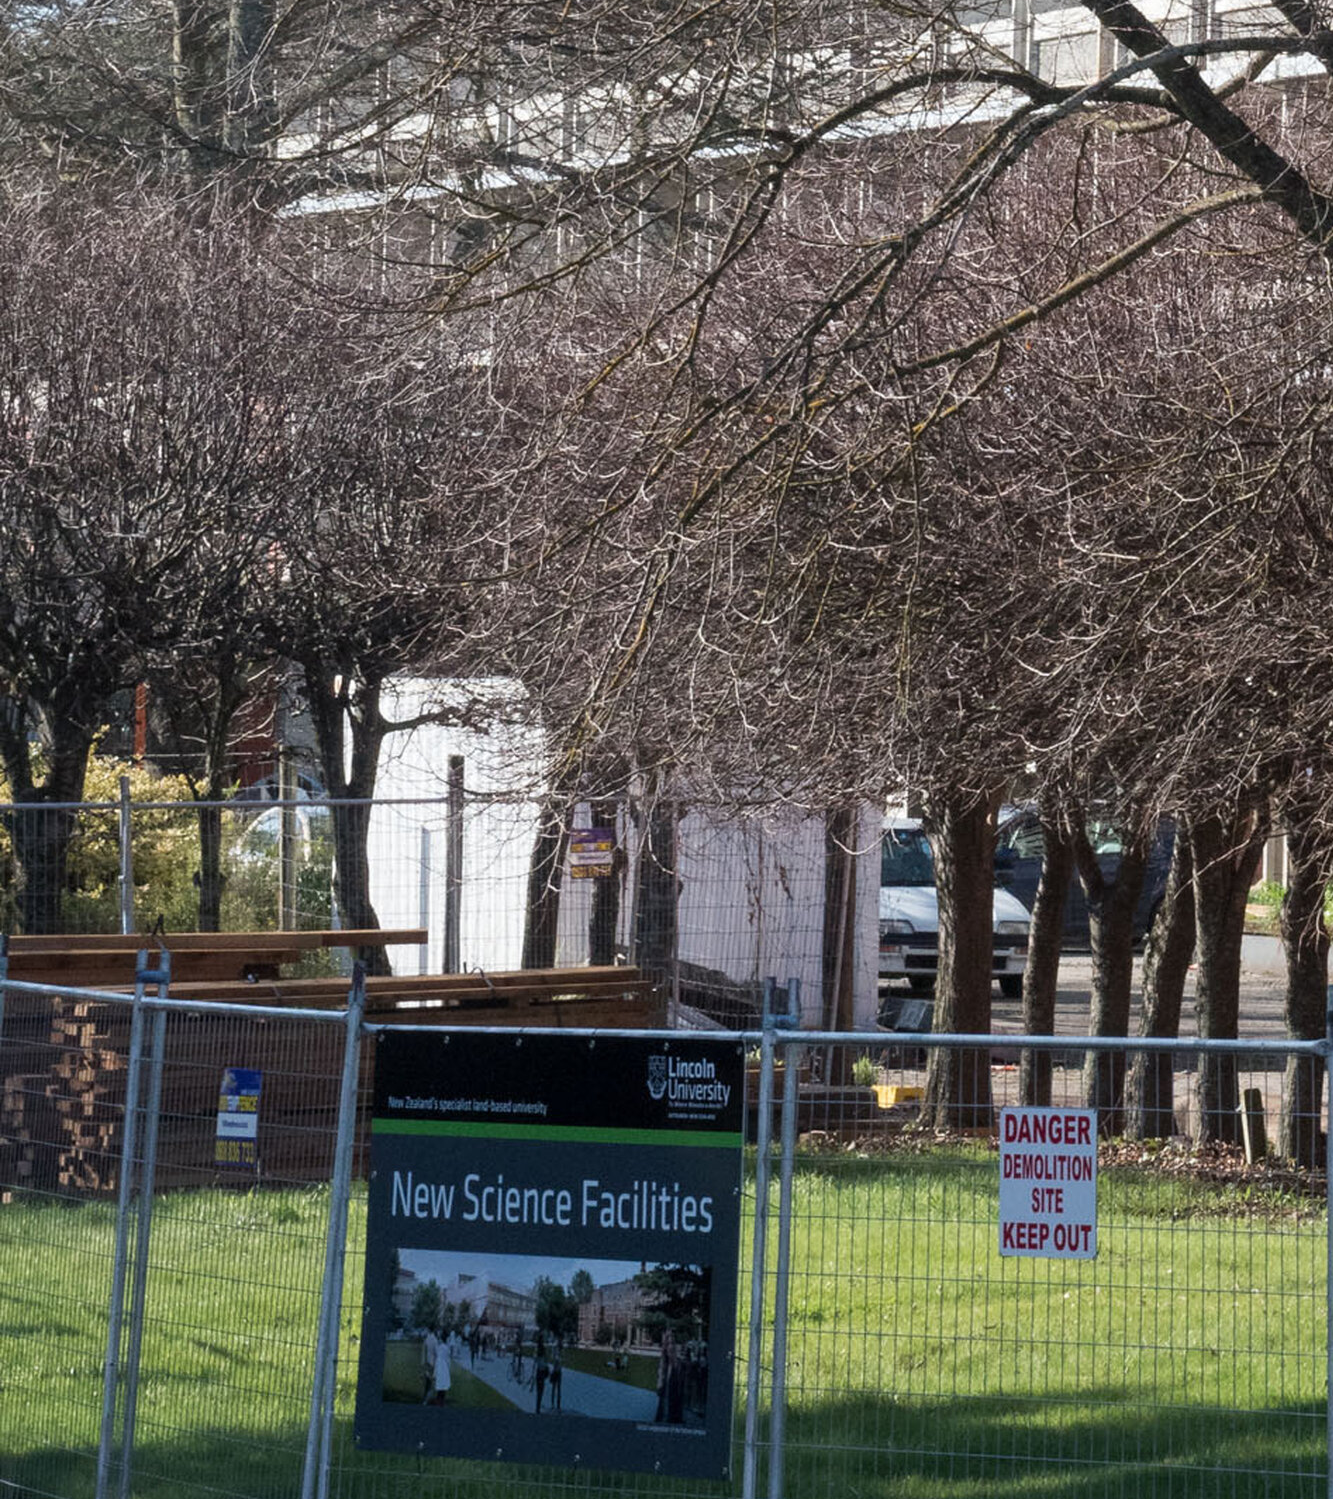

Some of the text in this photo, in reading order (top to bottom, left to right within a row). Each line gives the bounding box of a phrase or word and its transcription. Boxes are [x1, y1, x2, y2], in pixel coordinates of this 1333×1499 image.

[668, 1056, 715, 1078] Lincoln
[388, 1096, 404, 1109] New
[668, 1079, 731, 1106] University
[1004, 1114, 1091, 1145] DANGER
[1003, 1154, 1092, 1181] DEMOLITION
[392, 1171, 713, 1234] New Science Facilities
[1032, 1188, 1064, 1213] SITE
[1003, 1222, 1092, 1251] KEEP OUT
